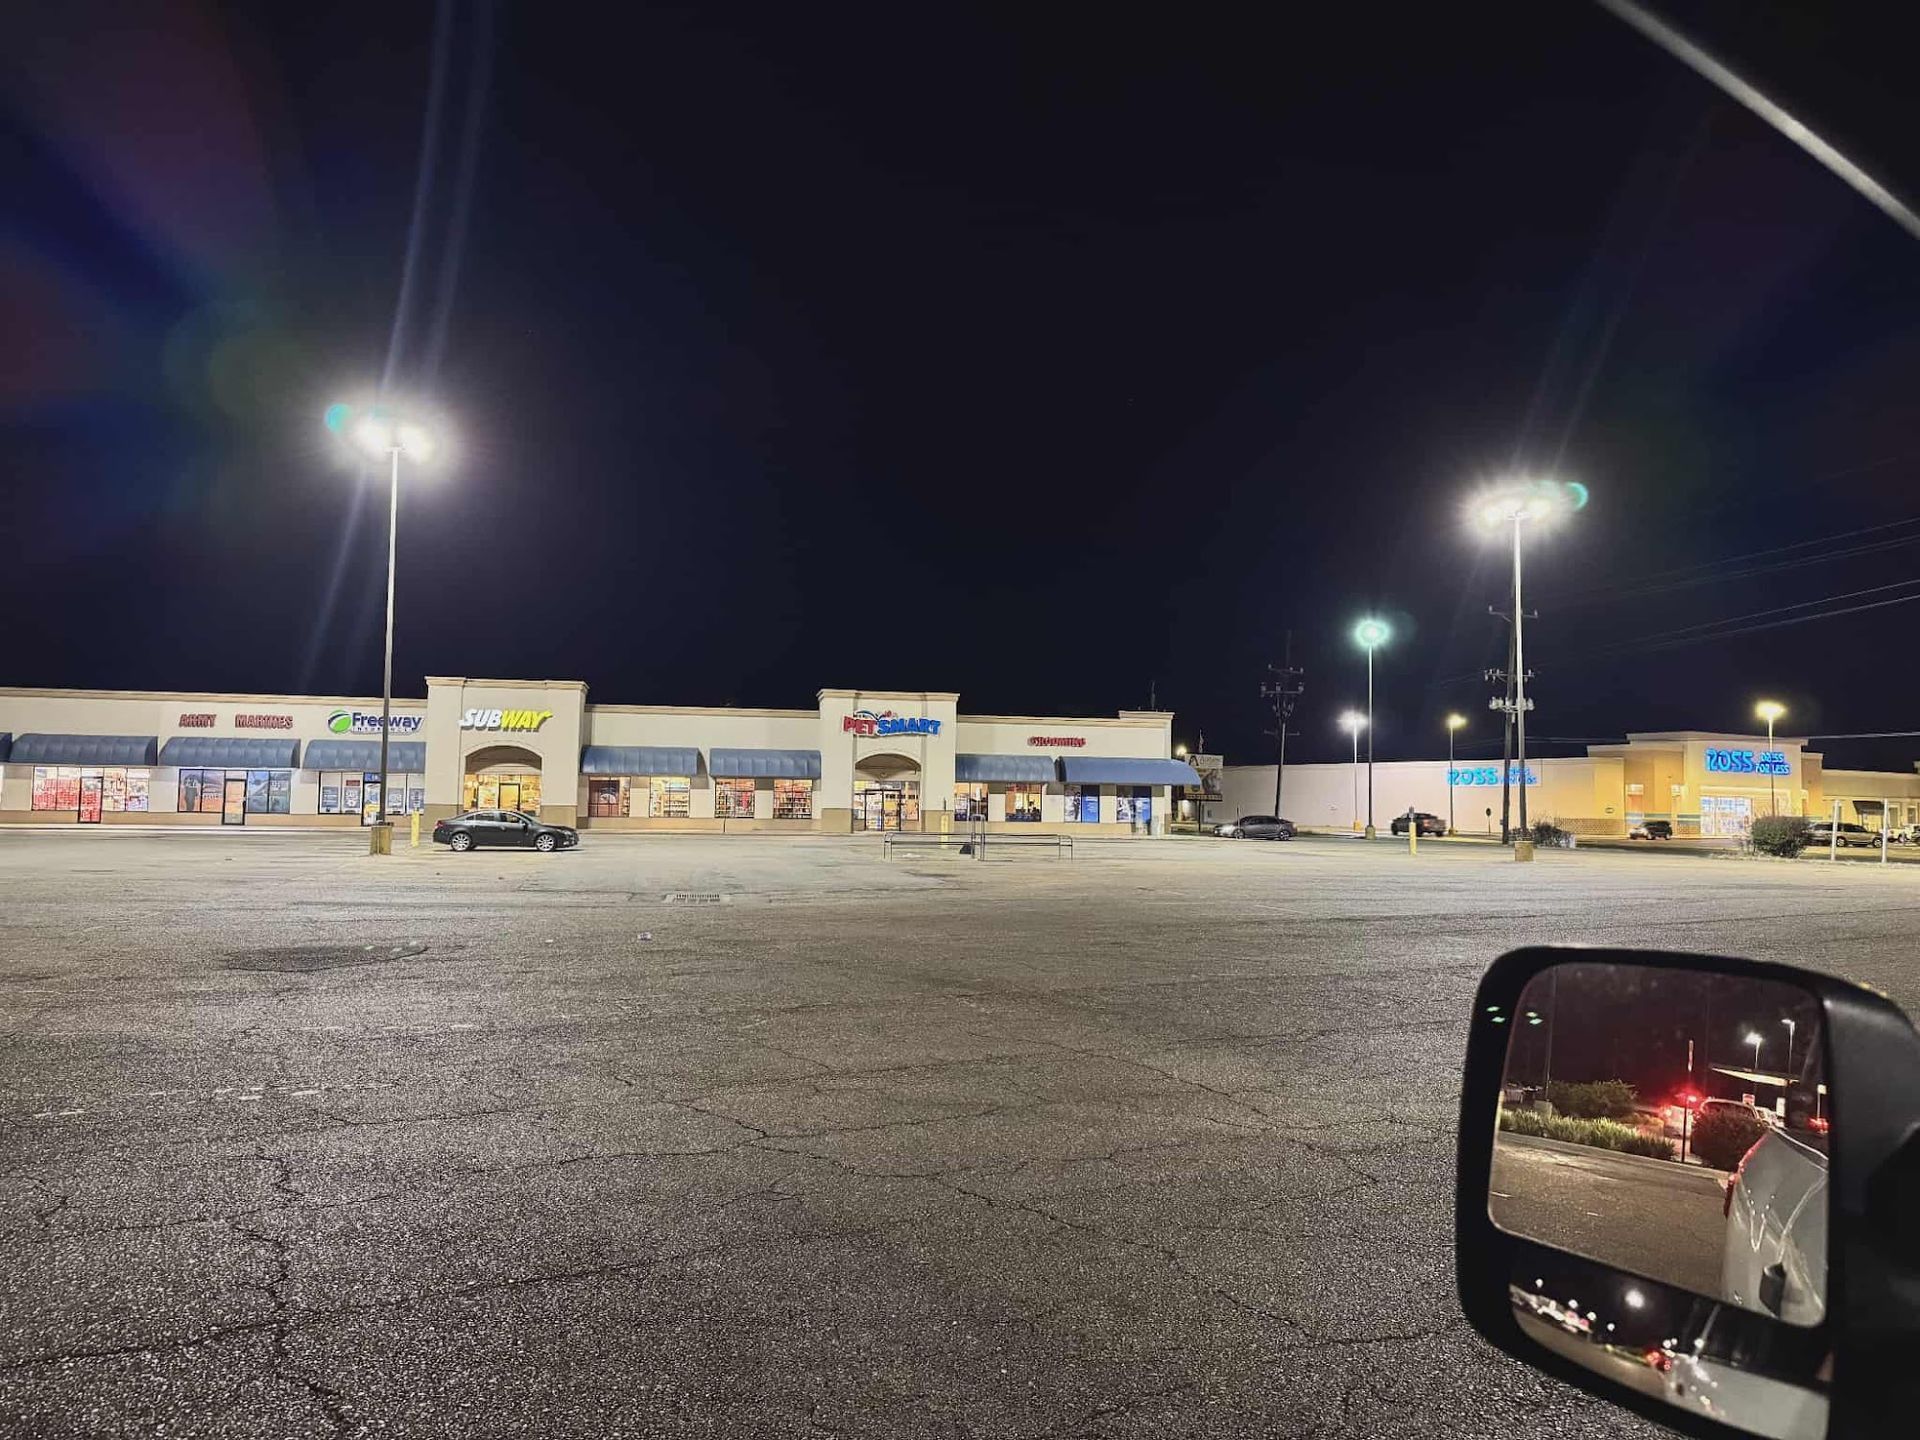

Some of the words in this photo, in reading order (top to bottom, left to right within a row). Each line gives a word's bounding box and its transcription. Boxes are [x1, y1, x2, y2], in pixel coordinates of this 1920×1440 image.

[179, 714, 216, 728] ARMY
[235, 715, 293, 729] MARINES
[459, 708, 553, 732] SUBWAY
[1706, 749, 1754, 772] ROSS
[1447, 767, 1498, 785] ROSS
